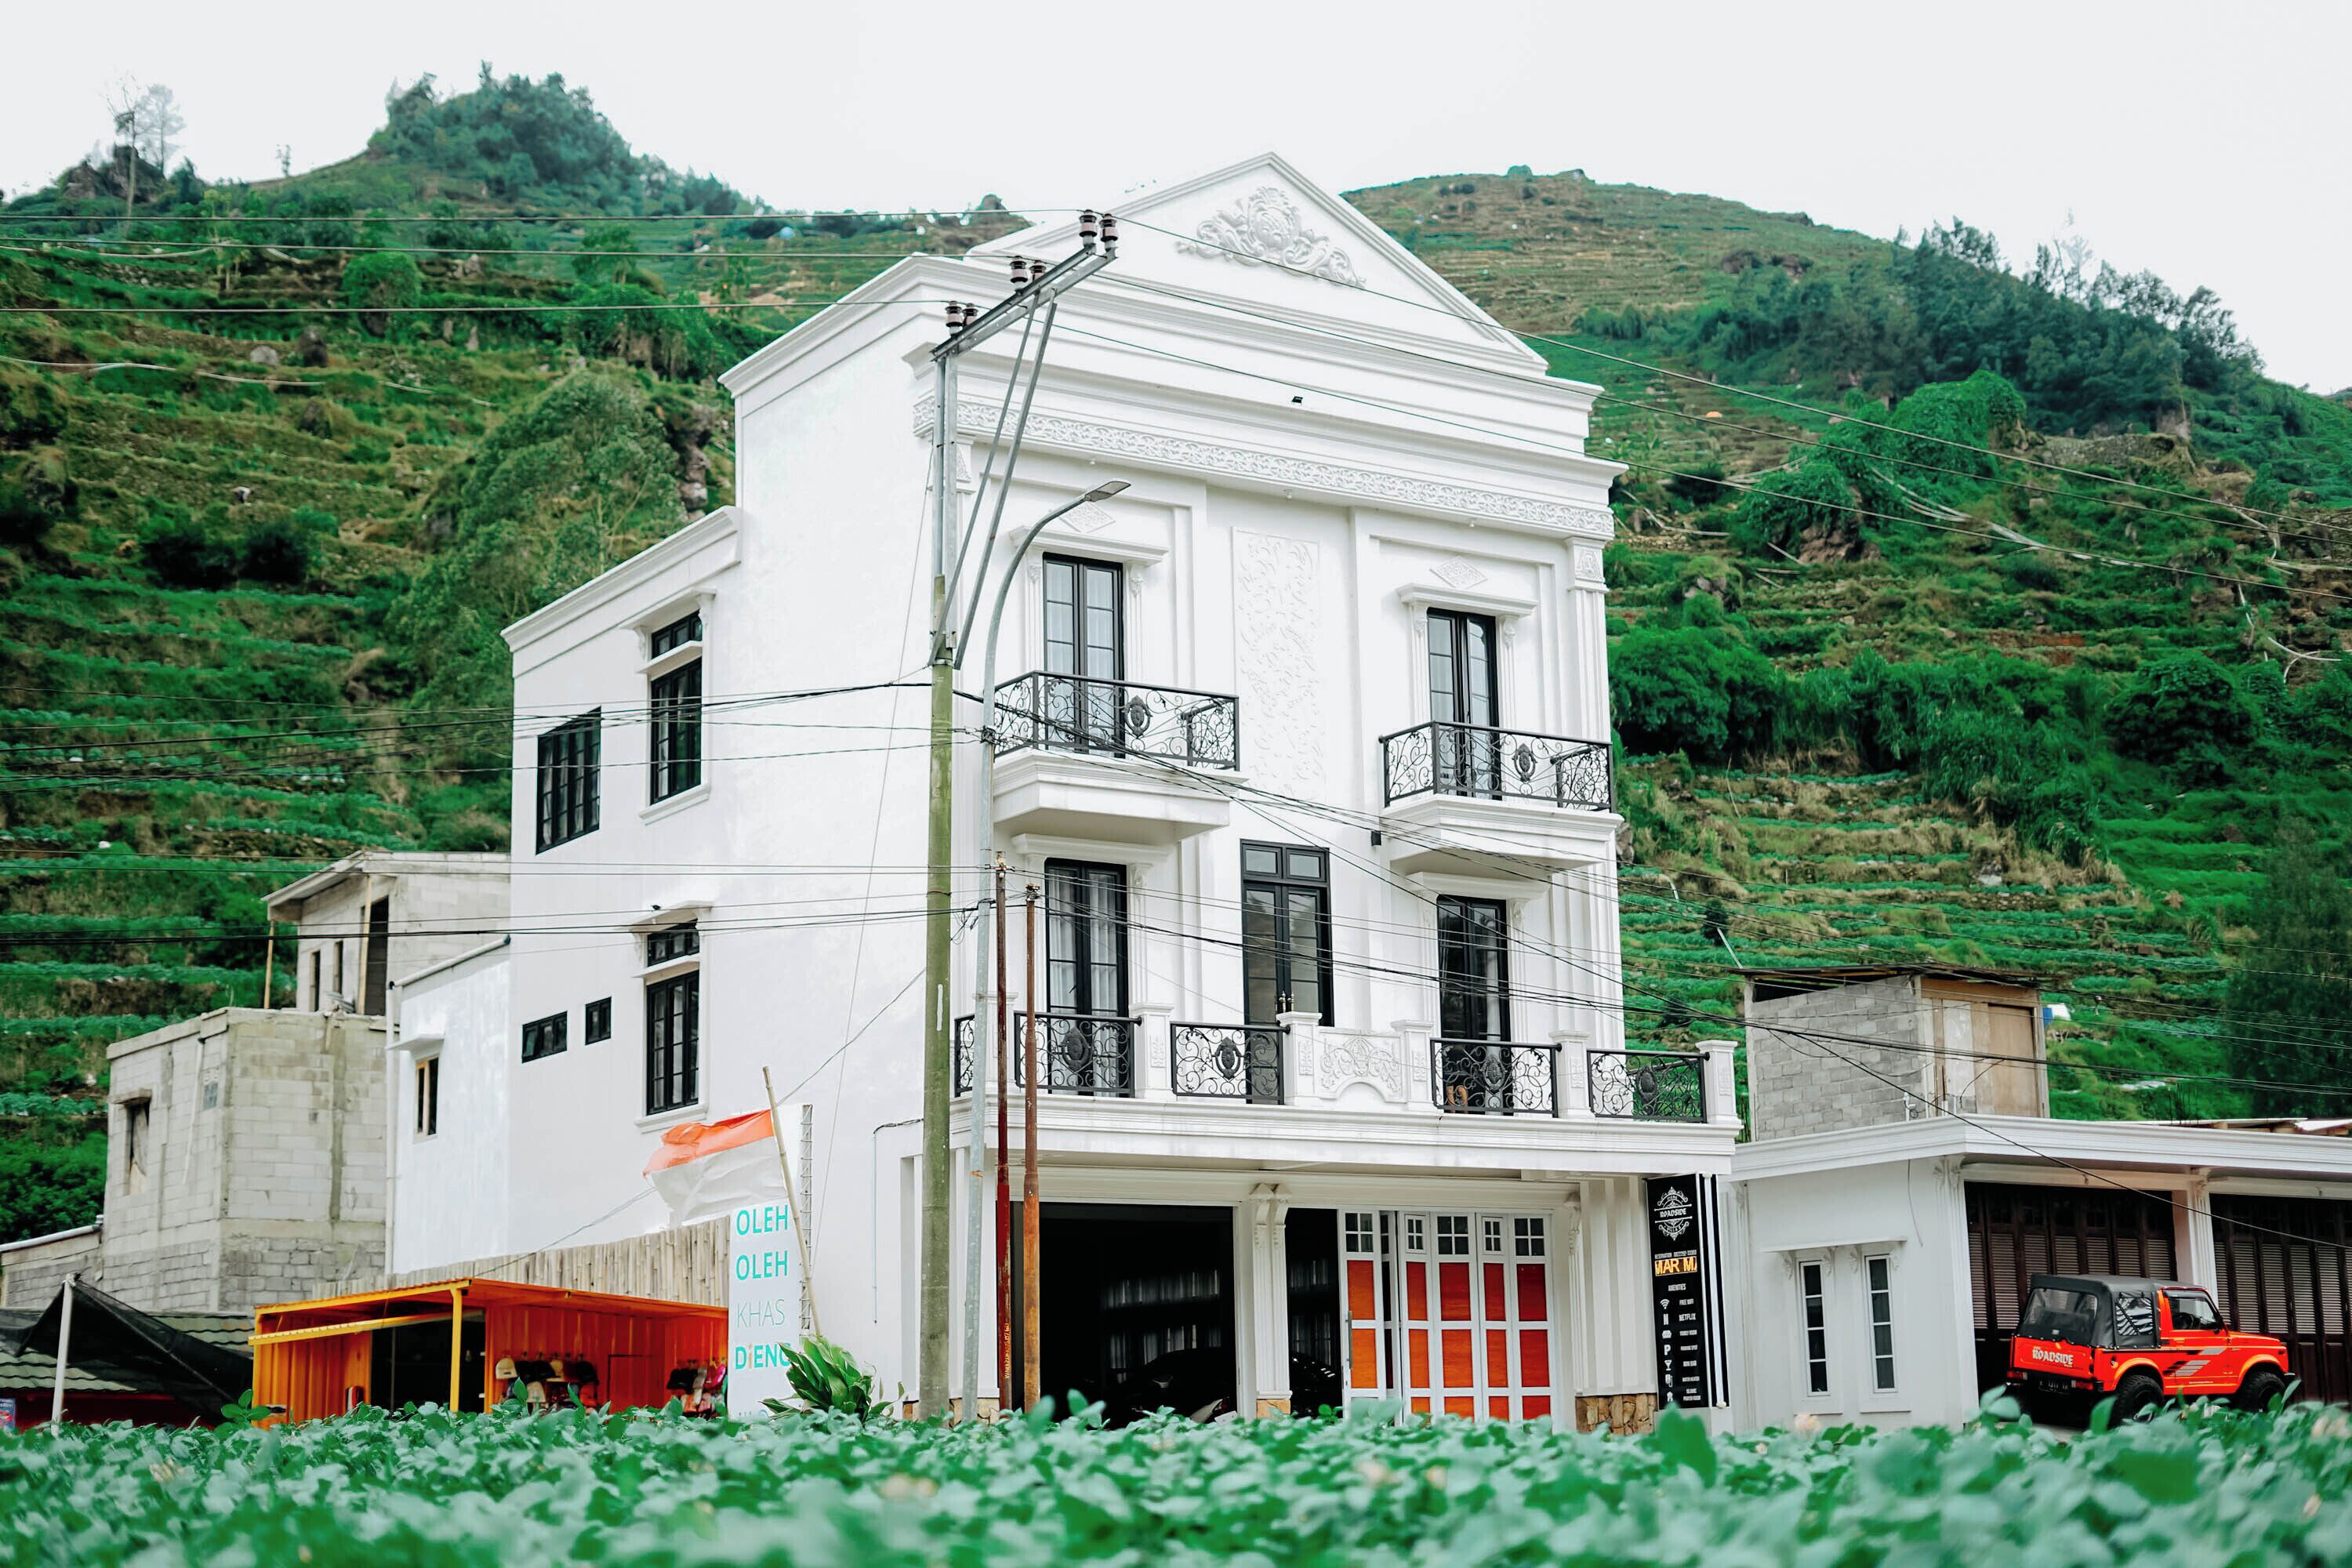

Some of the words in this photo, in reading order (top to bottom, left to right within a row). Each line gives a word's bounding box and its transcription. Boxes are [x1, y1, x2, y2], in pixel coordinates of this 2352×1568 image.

[736, 1204, 788, 1236] OLEH
[1660, 1207, 1686, 1218] ROADSIDE
[736, 1250, 787, 1280] OLEH
[737, 1298, 785, 1328] KHAS
[2032, 1348, 2074, 1365] ROADSIDE
